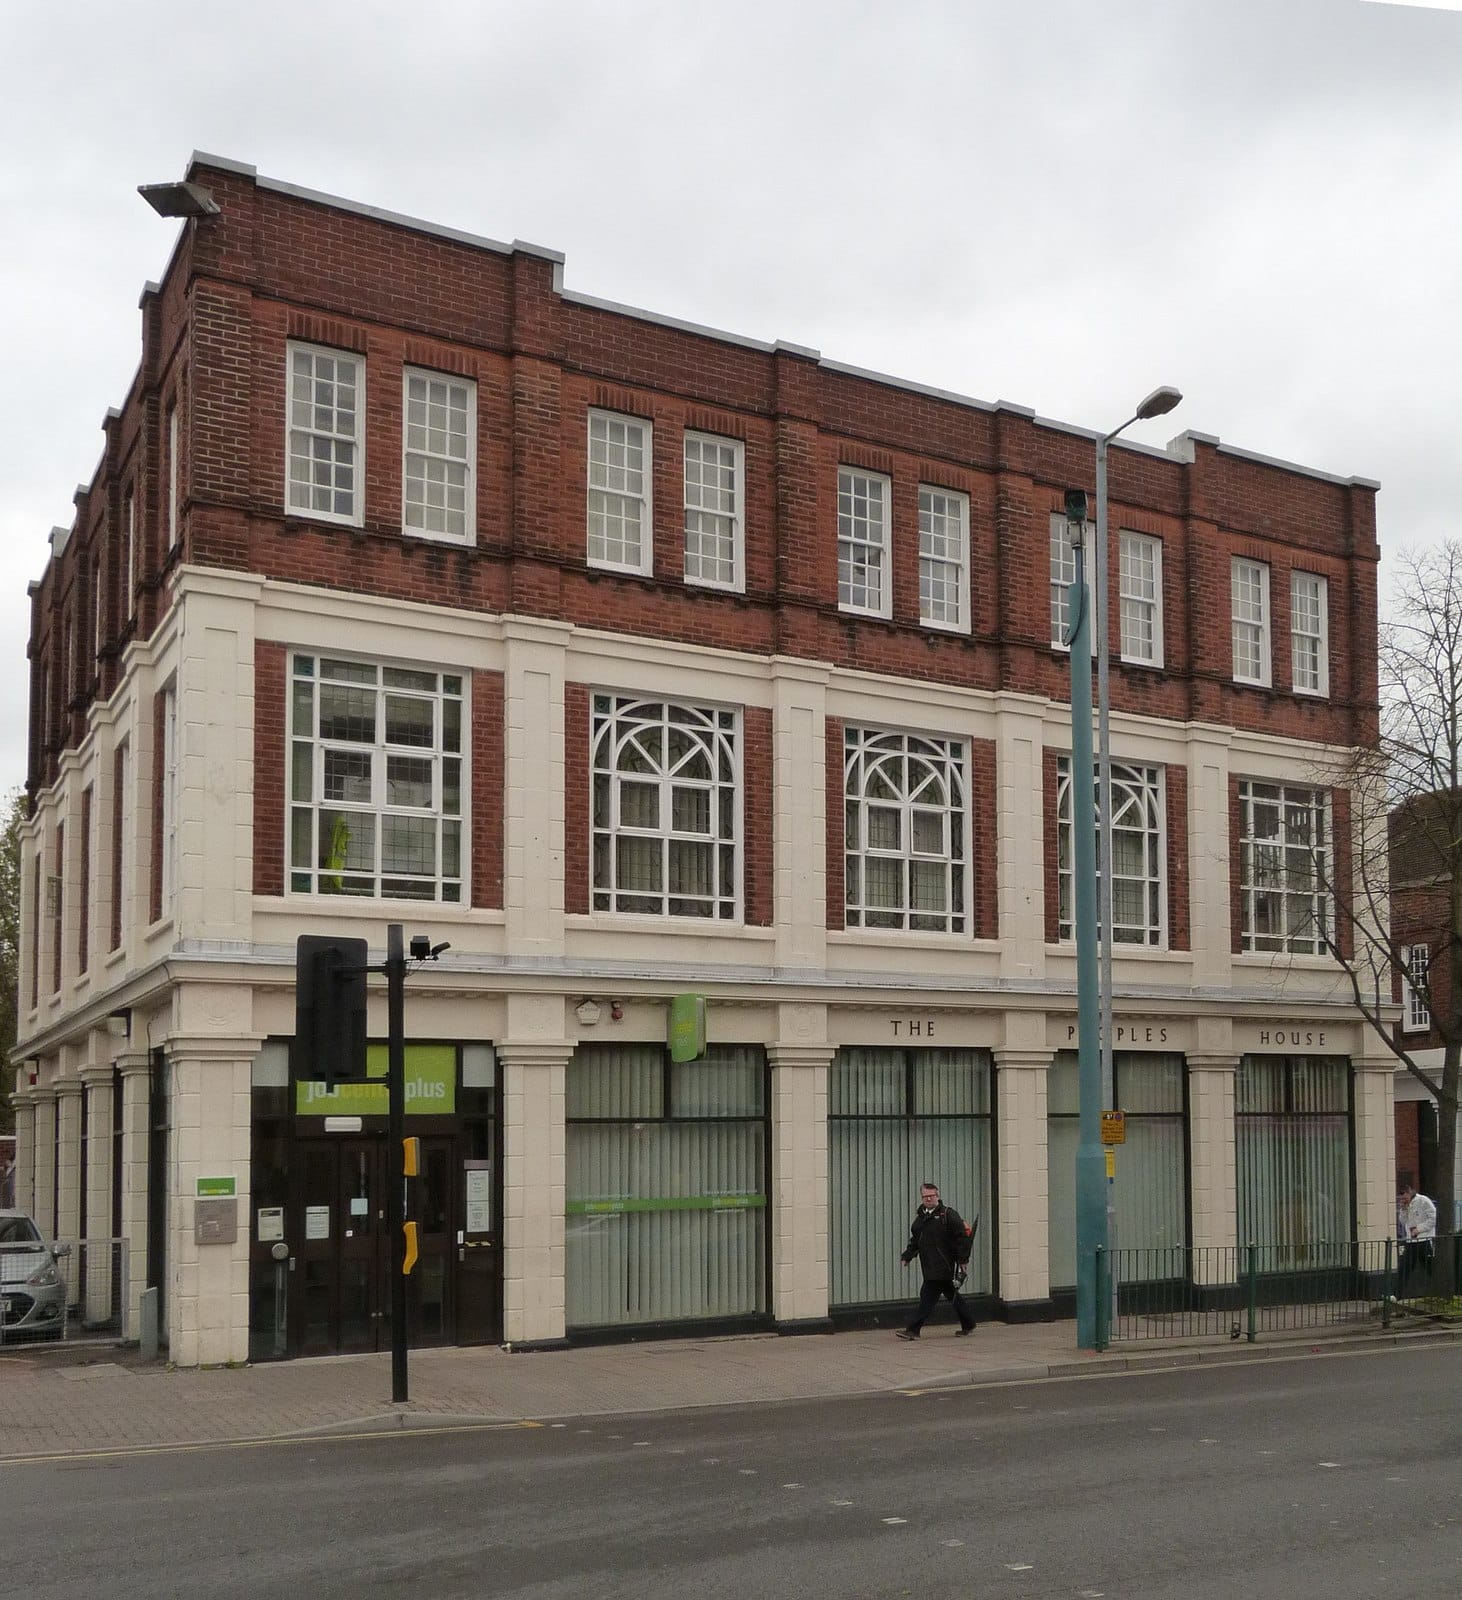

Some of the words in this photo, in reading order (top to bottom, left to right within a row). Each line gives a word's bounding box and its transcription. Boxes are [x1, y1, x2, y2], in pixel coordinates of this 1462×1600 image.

[890, 1020, 935, 1037] THE
[1067, 1025, 1168, 1043] PPLES
[1260, 1030, 1326, 1046] HOUSE
